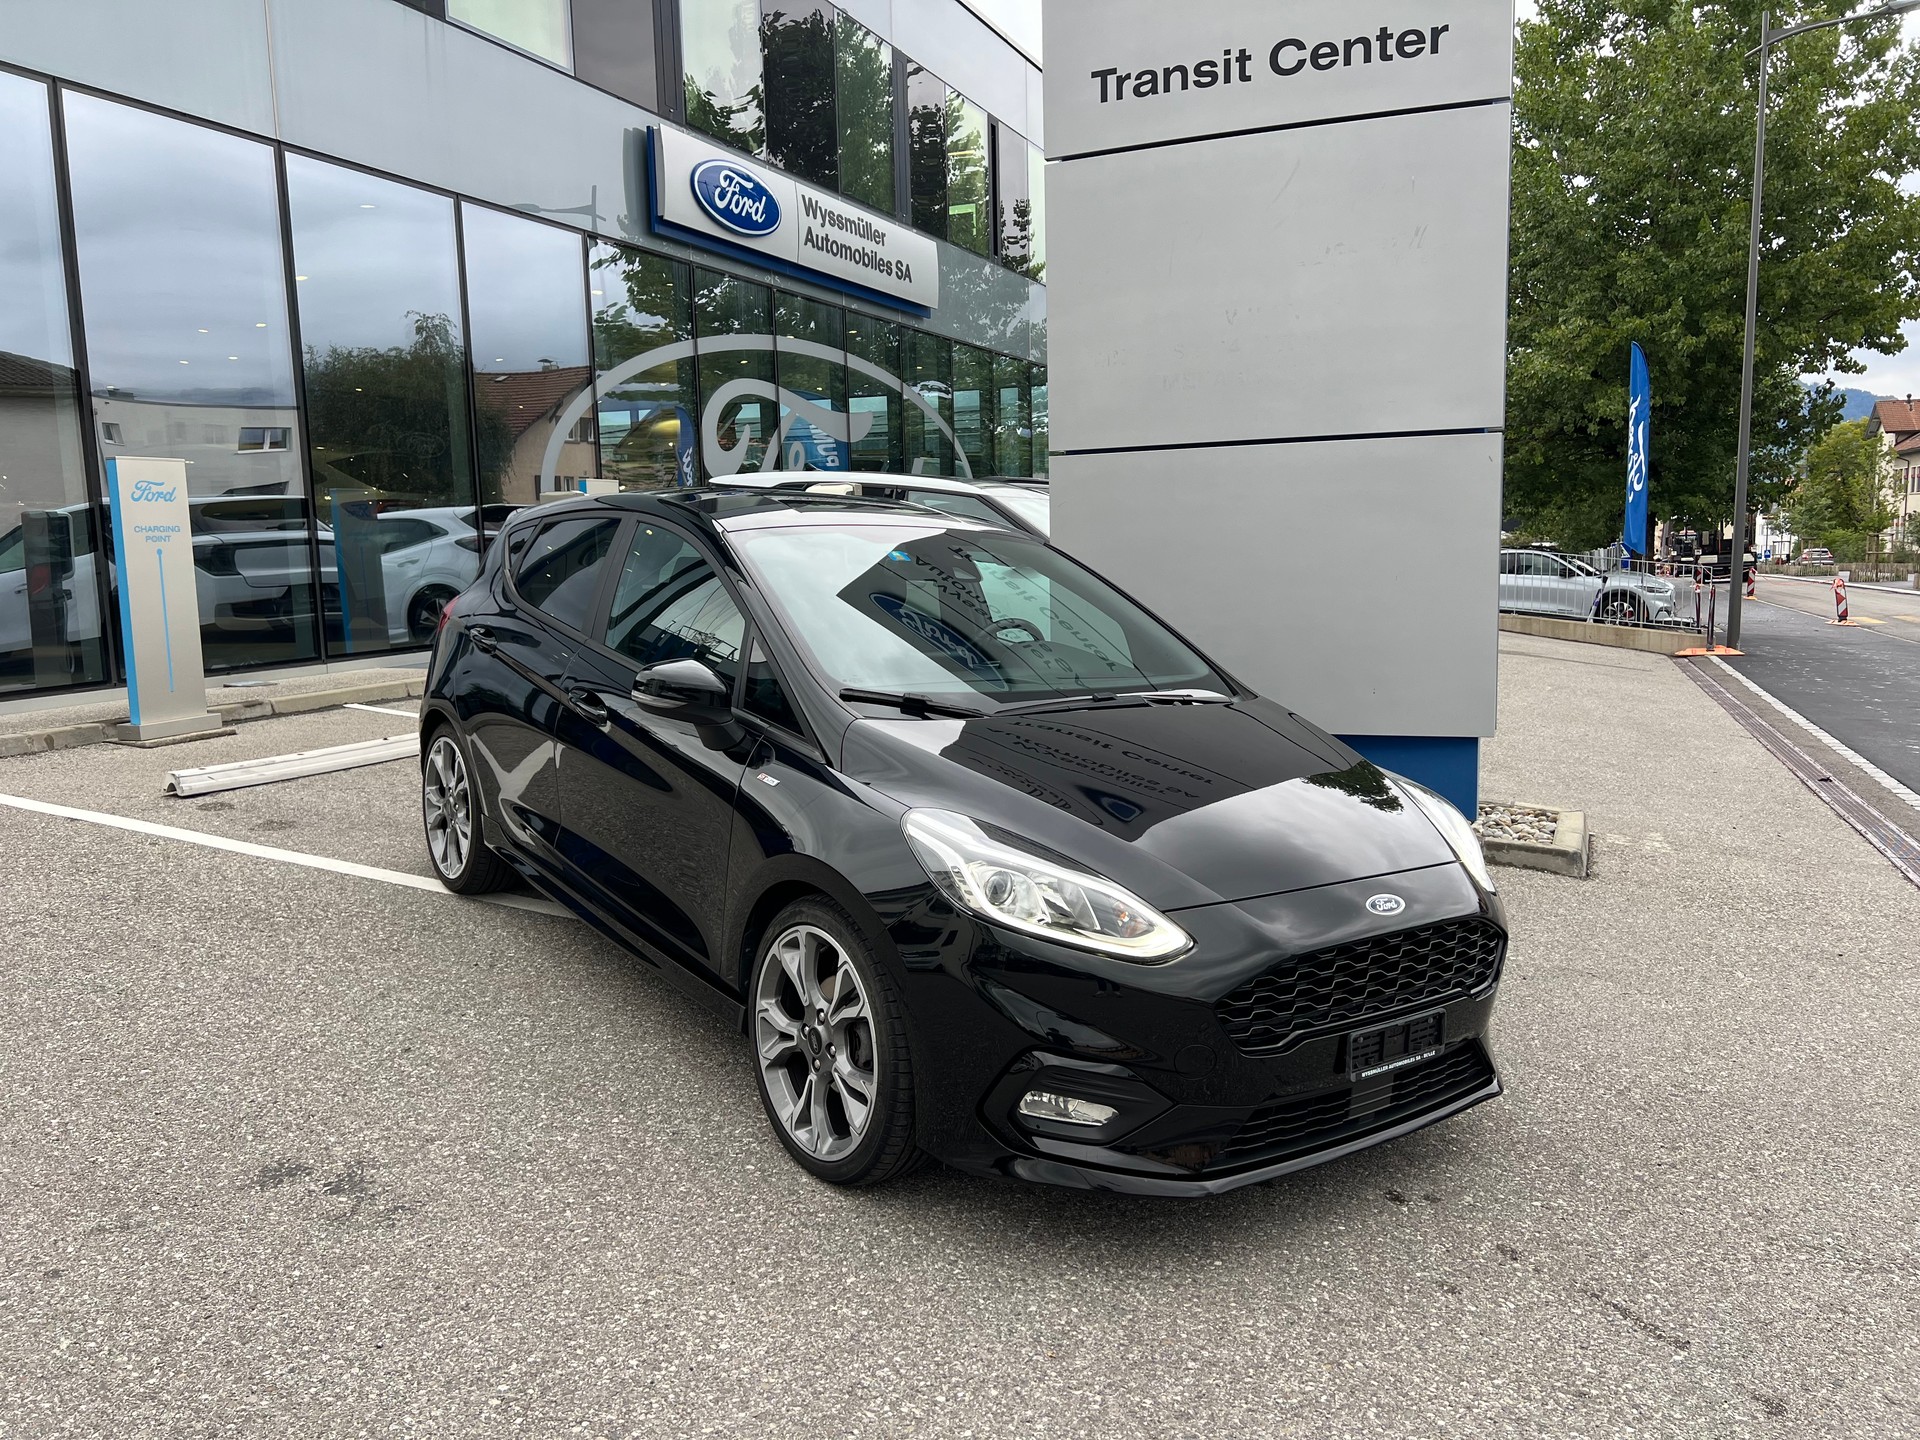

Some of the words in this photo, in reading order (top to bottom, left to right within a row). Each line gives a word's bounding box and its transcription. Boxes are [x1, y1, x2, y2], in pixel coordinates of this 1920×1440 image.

[1091, 48, 1252, 104] Transit
[1269, 24, 1449, 77] Center
[715, 170, 766, 223] Ford
[801, 194, 886, 247] Wyssmüller
[803, 226, 893, 277] Automobiles
[895, 259, 913, 284] SA
[131, 480, 177, 502] Ford
[134, 525, 181, 533] CHARGING
[145, 535, 172, 543] POINT
[1375, 897, 1398, 911] Ford
